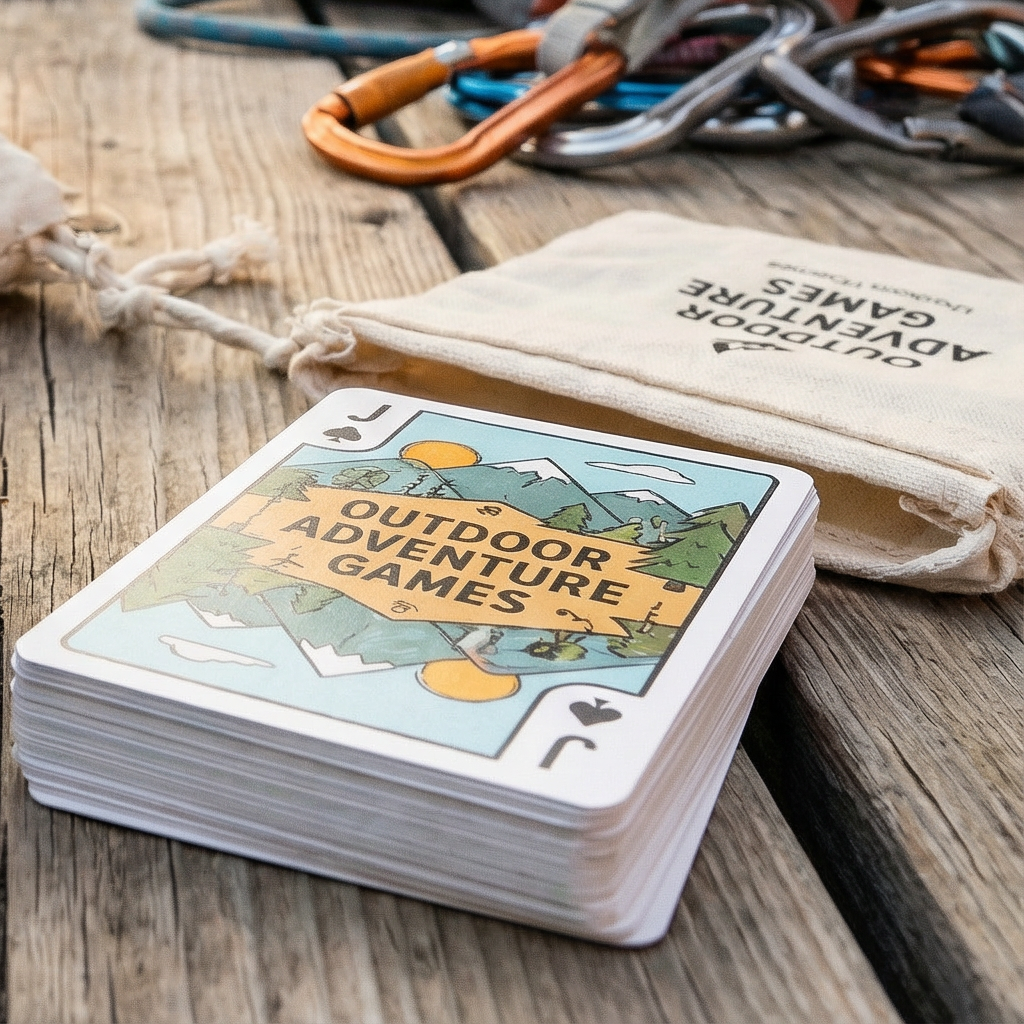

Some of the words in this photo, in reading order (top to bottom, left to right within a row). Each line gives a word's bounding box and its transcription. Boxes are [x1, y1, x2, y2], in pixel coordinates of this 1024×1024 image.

[678, 278, 992, 362] ADVENTURE
[762, 278, 936, 328] GAMES
[280, 515, 631, 606] ADVENTURE
[340, 499, 612, 572] OUTDOOR
[327, 553, 532, 614] GAMES
